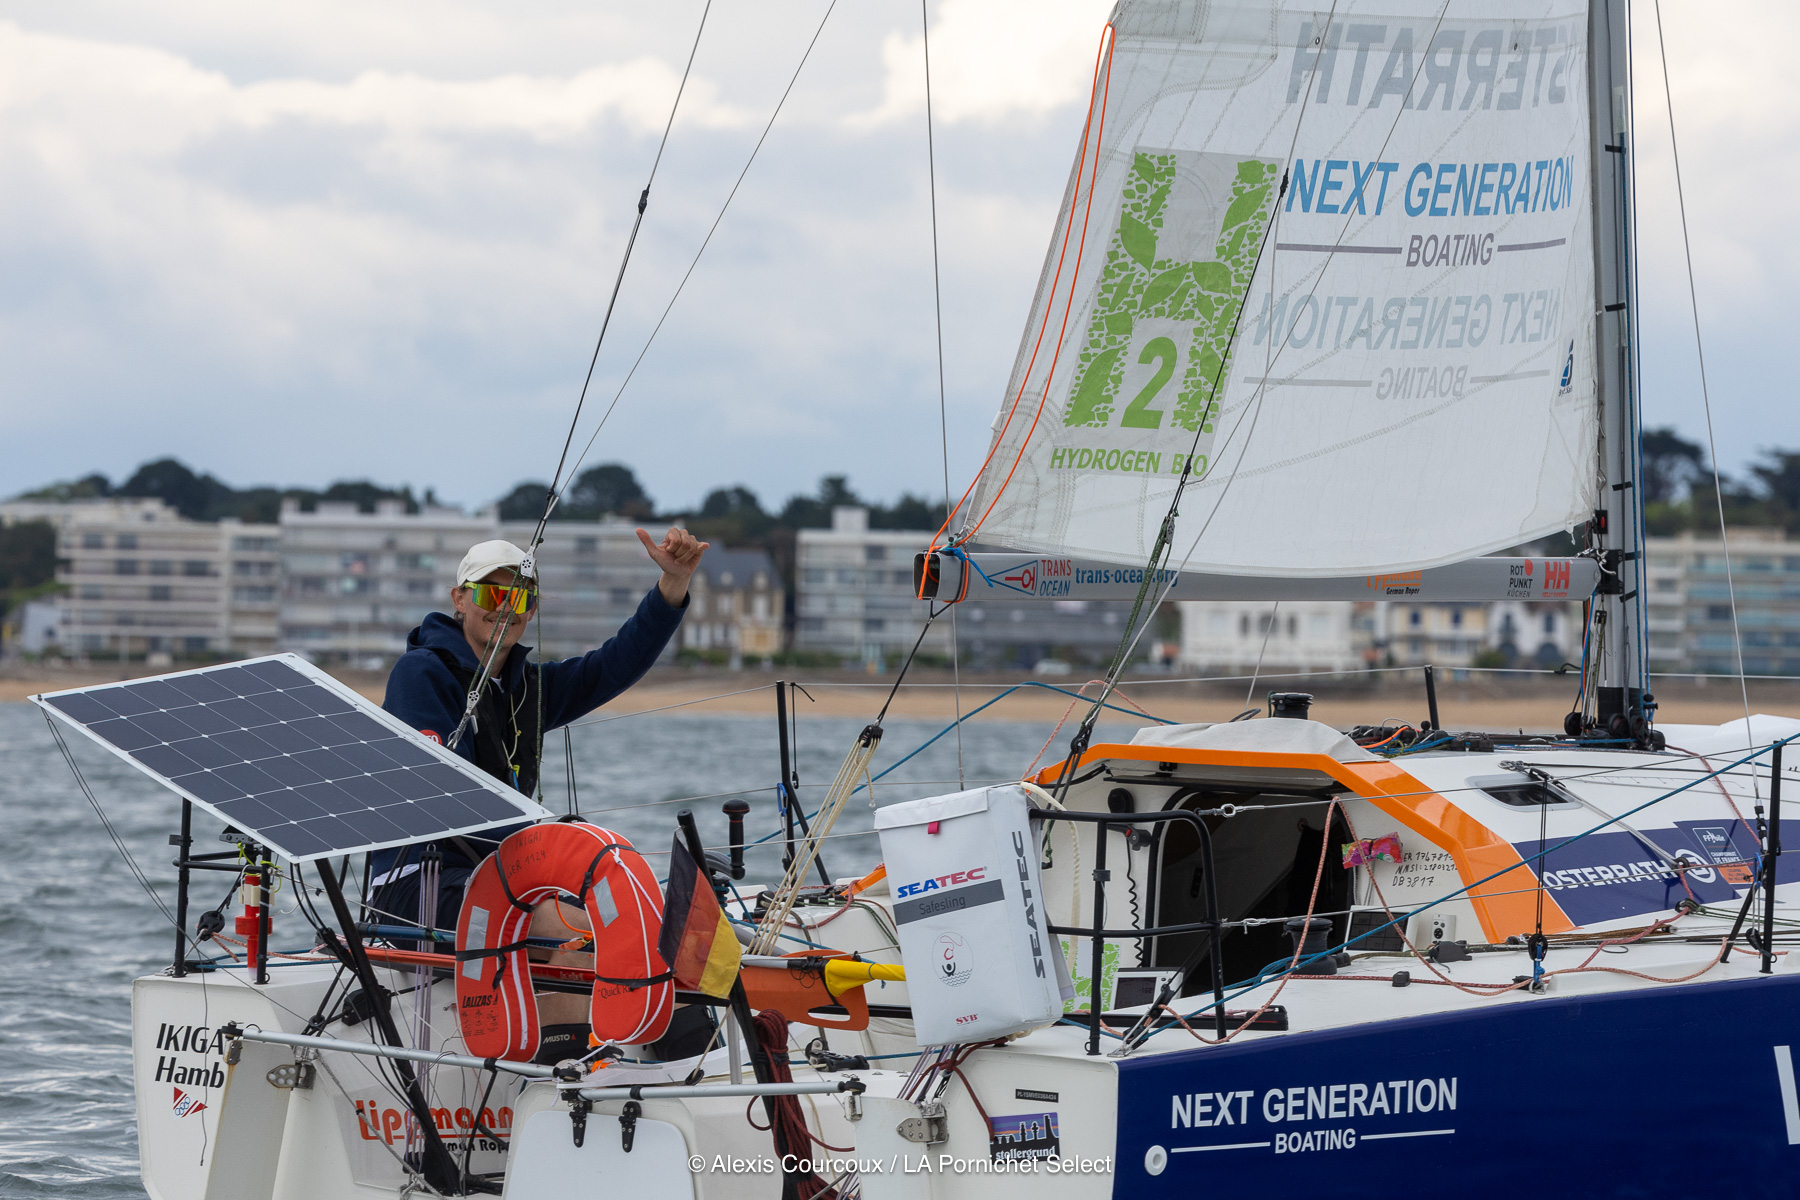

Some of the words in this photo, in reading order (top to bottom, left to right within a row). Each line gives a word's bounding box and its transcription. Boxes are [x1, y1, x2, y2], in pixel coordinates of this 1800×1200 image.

[1285, 158, 1399, 216] NEXT
[1404, 155, 1574, 217] GENERATION
[1406, 233, 1494, 267] BOATING
[1050, 448, 1162, 473] HYDROGEN
[1041, 559, 1072, 577] TRANS
[1076, 567, 1179, 587] trans-ocea.org
[1509, 578, 1533, 588] PUNKT
[1510, 565, 1524, 576] ROT
[1544, 561, 1570, 589] HH
[1039, 580, 1071, 597] OCEAN
[507, 859, 522, 878] GER
[1543, 860, 1679, 890] OSTERRATH
[919, 896, 966, 915] Safesling
[1012, 830, 1046, 979] SEATEC
[462, 994, 493, 1008] LALIZAS
[956, 1014, 978, 1025] SVB
[156, 1023, 224, 1056] IKIGA
[542, 1034, 570, 1045] MUSTO
[155, 1055, 225, 1089] Hamb
[1171, 1090, 1254, 1129] NEXT
[1263, 1077, 1458, 1123] GENERATION
[1275, 1128, 1356, 1154] BOATING
[995, 1145, 1056, 1163] stollergrund
